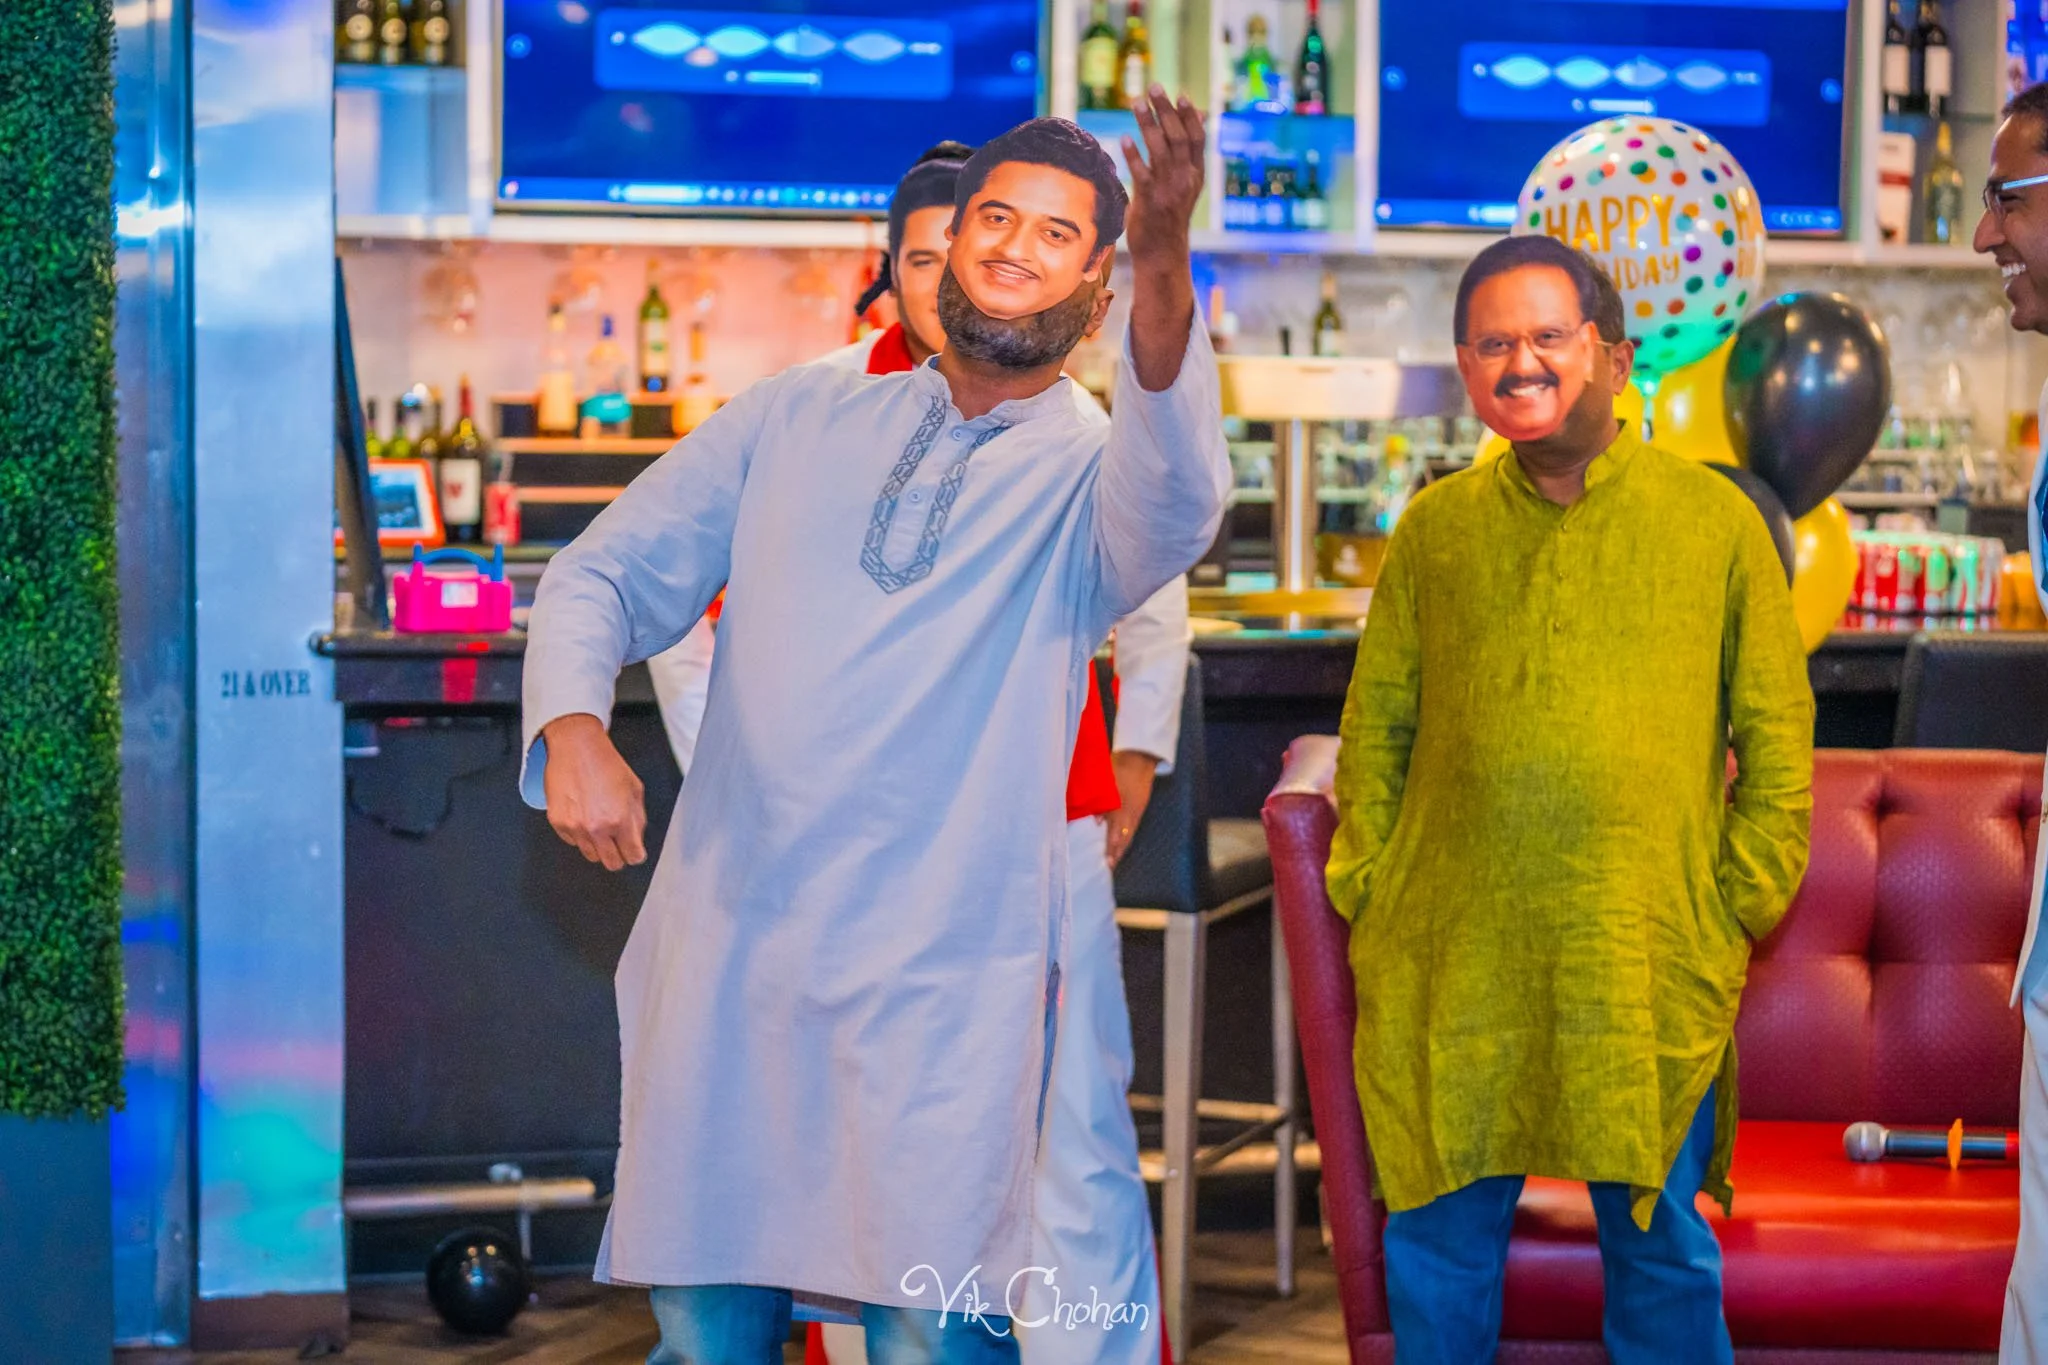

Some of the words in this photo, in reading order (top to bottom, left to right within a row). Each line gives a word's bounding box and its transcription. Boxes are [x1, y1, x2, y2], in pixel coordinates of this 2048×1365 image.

[1545, 194, 1675, 253] HAPPY
[221, 670, 239, 698] 21
[245, 670, 256, 698] &
[261, 669, 311, 698] OVER
